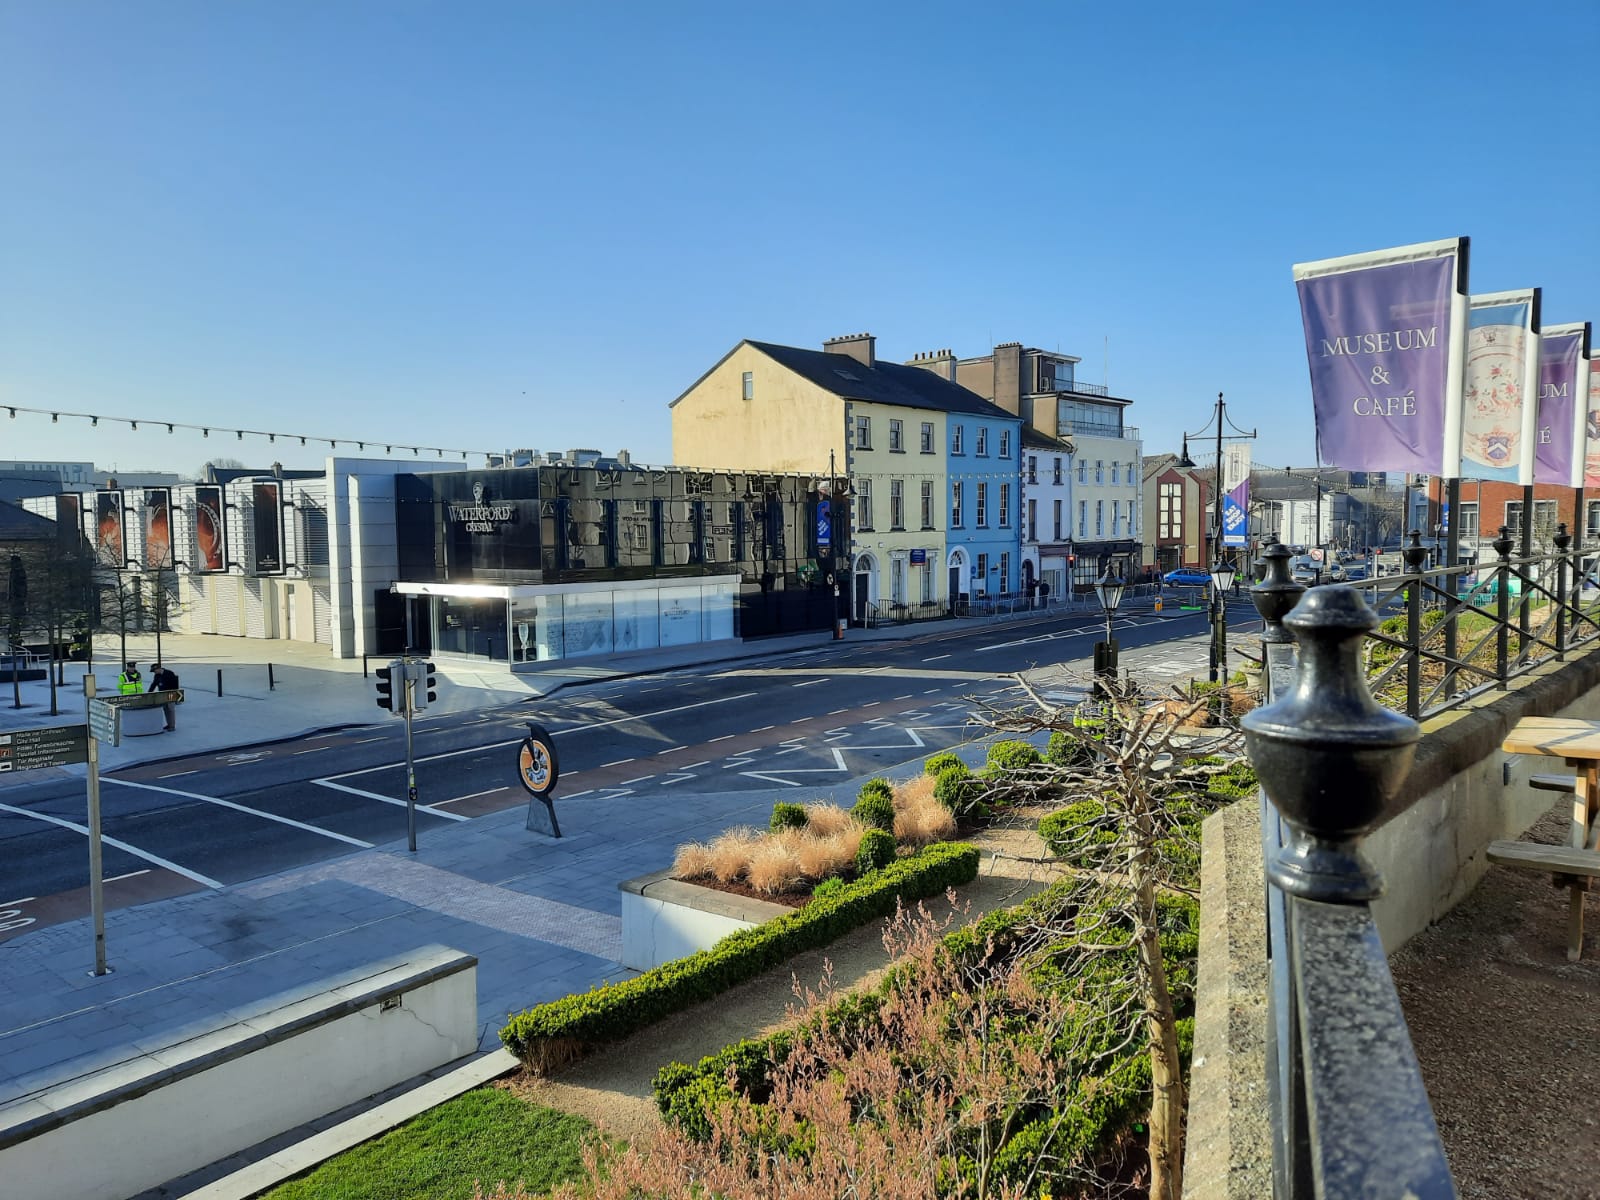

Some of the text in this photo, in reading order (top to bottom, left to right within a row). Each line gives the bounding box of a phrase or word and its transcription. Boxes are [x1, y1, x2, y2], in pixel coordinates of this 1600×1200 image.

[1320, 326, 1438, 357] MUSEUM
[1370, 365, 1390, 385] &
[1353, 390, 1417, 417] CAFÉ
[448, 504, 511, 522] WATERFORD
